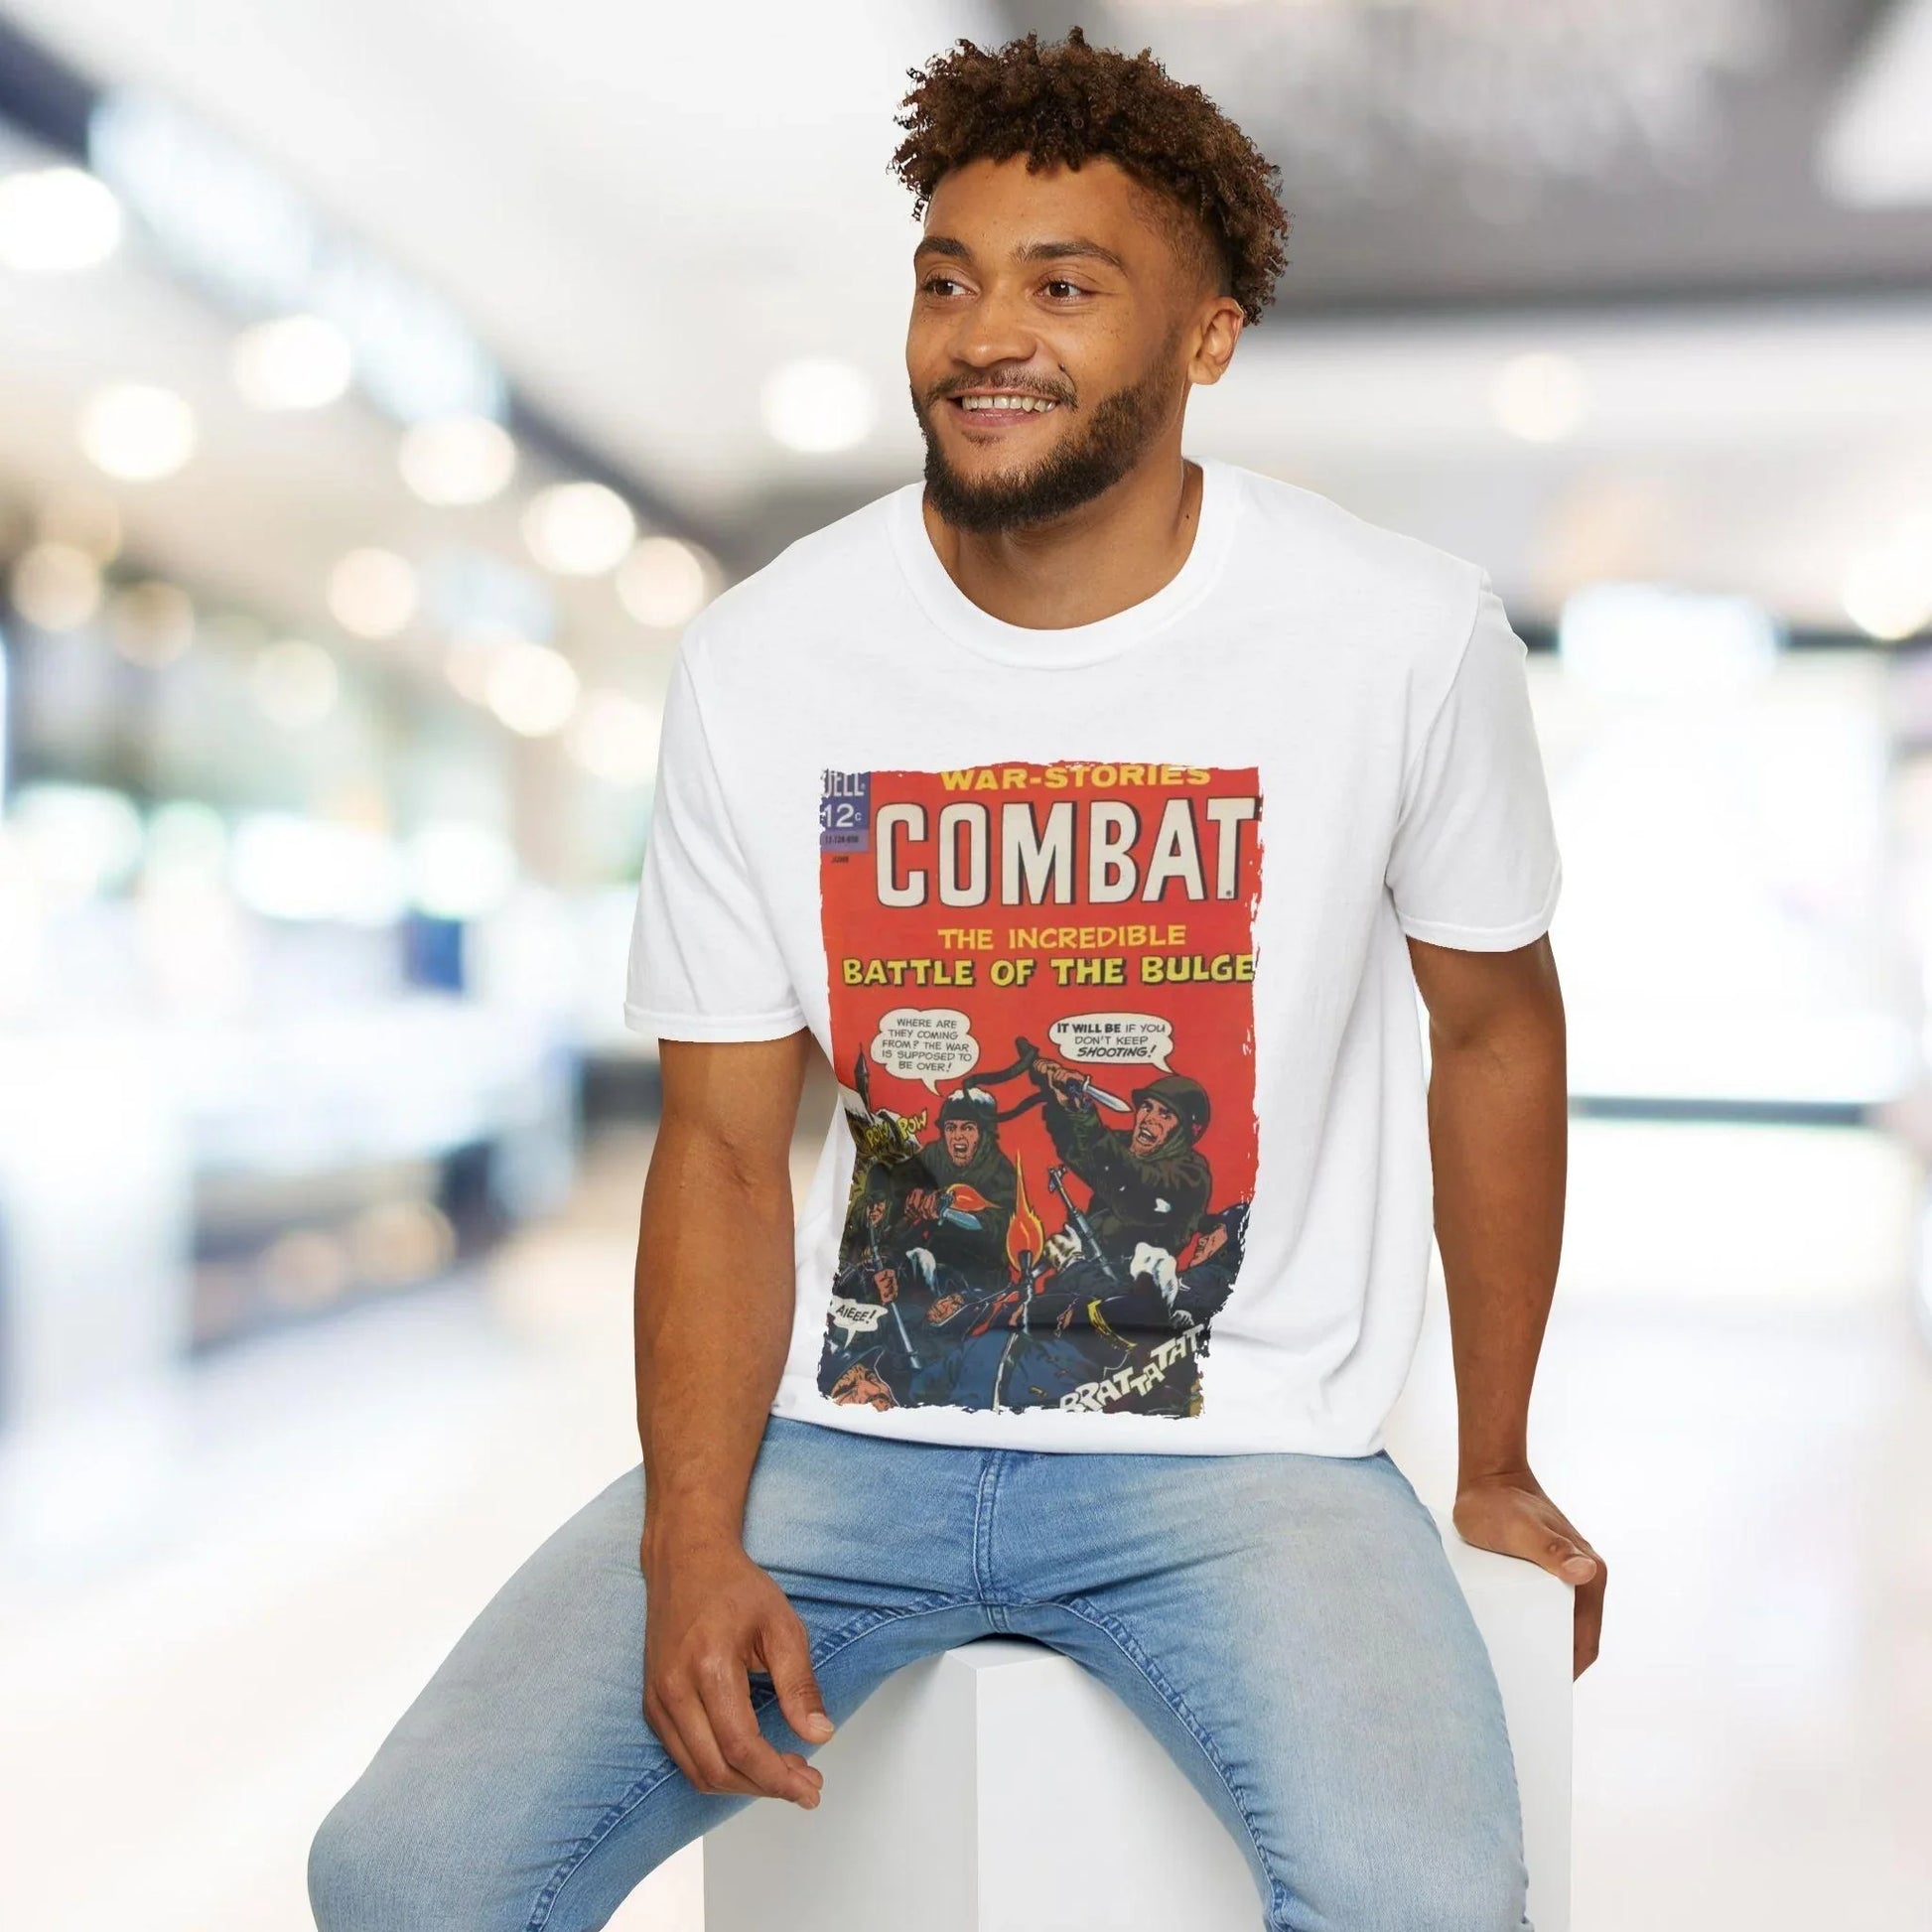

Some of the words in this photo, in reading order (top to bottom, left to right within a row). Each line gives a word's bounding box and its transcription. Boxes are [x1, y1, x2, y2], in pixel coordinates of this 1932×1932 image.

[941, 764, 1211, 791] WAR-STORIES
[876, 796, 1258, 907] COMBAT
[937, 928, 994, 950] THE
[1009, 925, 1186, 949] INCREDIBLE
[842, 958, 976, 986] BATTLE
[990, 958, 1037, 987] OF
[1050, 957, 1127, 986] THE
[1141, 954, 1255, 984] BULGE
[897, 1019, 932, 1028] WHERE
[935, 1020, 958, 1029] ARE
[1057, 1024, 1069, 1034] IT
[1072, 1024, 1102, 1034] WILL
[1104, 1024, 1121, 1034] BE
[1125, 1024, 1137, 1033] IF
[1140, 1024, 1166, 1033] YOU
[889, 1029, 913, 1038] THEY
[916, 1031, 959, 1040] COMING
[1074, 1035, 1112, 1045] DON'T
[1116, 1035, 1149, 1045] KEEP
[882, 1039, 919, 1049] FROM?
[923, 1041, 942, 1050] THE
[946, 1042, 970, 1052] WAR
[1077, 1045, 1157, 1057] SHOOTING!
[882, 1049, 893, 1059] IS
[897, 1050, 956, 1061] SUPPOSED
[958, 1052, 973, 1062] TO
[897, 1060, 912, 1070] BE
[915, 1061, 952, 1072] OVER!
[897, 1109, 927, 1140] POW
[835, 1304, 877, 1324] AIEEE!
